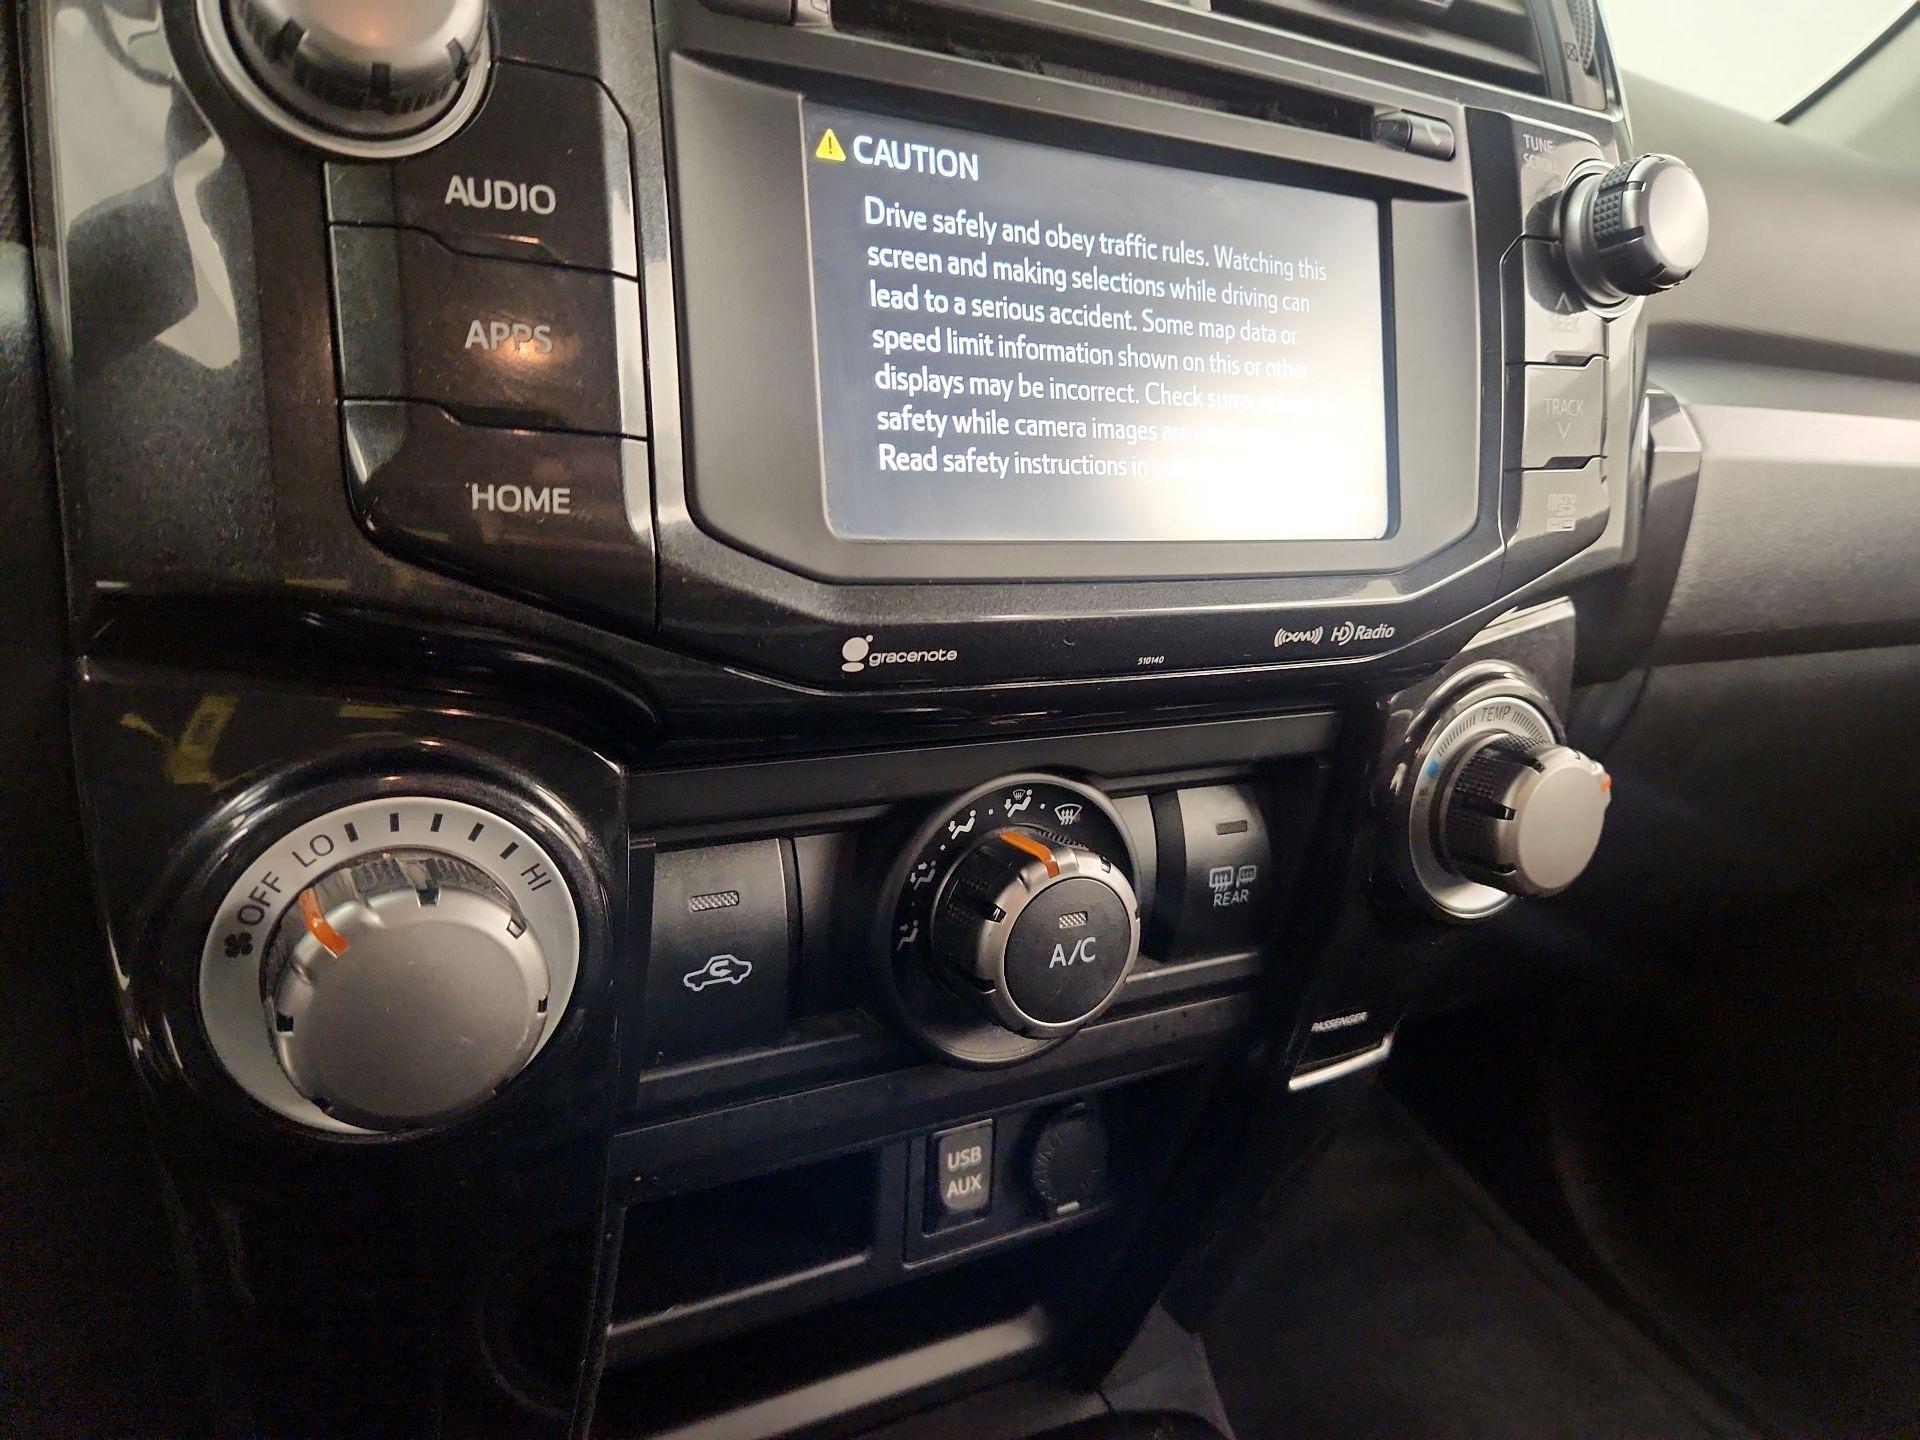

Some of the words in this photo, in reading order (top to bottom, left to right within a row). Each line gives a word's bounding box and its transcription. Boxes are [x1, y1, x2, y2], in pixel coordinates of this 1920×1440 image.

[852, 134, 980, 182] CAUTION
[1522, 134, 1554, 153] TUNE
[445, 175, 557, 215] AUDIO
[863, 195, 928, 231] Drive
[932, 208, 998, 246] safely
[1001, 219, 1041, 245] and
[1045, 222, 1095, 258] obey
[1099, 231, 1158, 261] traffic
[1161, 240, 1210, 268] rules.
[1212, 243, 1294, 282] Watching
[1297, 257, 1328, 281] this
[867, 245, 943, 274] screen
[947, 251, 987, 278] and
[993, 257, 1067, 293] making
[1071, 265, 1165, 299] selections
[1169, 276, 1217, 303] while
[1221, 281, 1278, 314] driving
[1282, 294, 1310, 313] can
[869, 279, 919, 311] lead
[923, 289, 949, 314] to
[953, 295, 966, 316] a
[971, 296, 1045, 323] serious
[1049, 303, 1138, 332] accident.
[1141, 308, 1194, 337] Some
[1198, 322, 1236, 345] map
[1239, 319, 1277, 345] data
[1280, 329, 1298, 346] or
[464, 319, 553, 353] APPS
[871, 326, 941, 356] speed
[946, 327, 995, 357] limit
[997, 333, 1114, 367] information
[1117, 343, 1178, 371] shown
[1182, 356, 1205, 374] on
[1208, 351, 1240, 376] this
[1243, 360, 1262, 377] or
[1265, 357, 1309, 380] other
[874, 362, 965, 399] displays
[969, 375, 1014, 402] may
[1018, 371, 1045, 399] be
[1049, 376, 1141, 405] incorrect.
[1144, 381, 1204, 409] Check
[1543, 397, 1584, 417] TRACK
[876, 404, 948, 439] safety
[951, 407, 1010, 435] while
[1014, 417, 1087, 438] camera
[1091, 417, 1158, 445] images
[878, 442, 938, 472] Read
[942, 446, 1010, 480] safety
[1013, 450, 1128, 477] instructions
[1131, 455, 1148, 477] in
[470, 482, 571, 515] HOME
[1331, 622, 1355, 646] HD
[1354, 623, 1396, 640] Radio
[868, 648, 958, 667] gracenote
[1137, 655, 1165, 666] 510140
[1480, 705, 1511, 723] TEMP
[291, 833, 335, 868] LO
[520, 862, 553, 892] HI
[236, 871, 282, 926] OFF
[1213, 888, 1250, 907] REAR
[1048, 935, 1097, 969] A/C
[947, 1145, 983, 1173] USB
[946, 1173, 983, 1198] AUX
